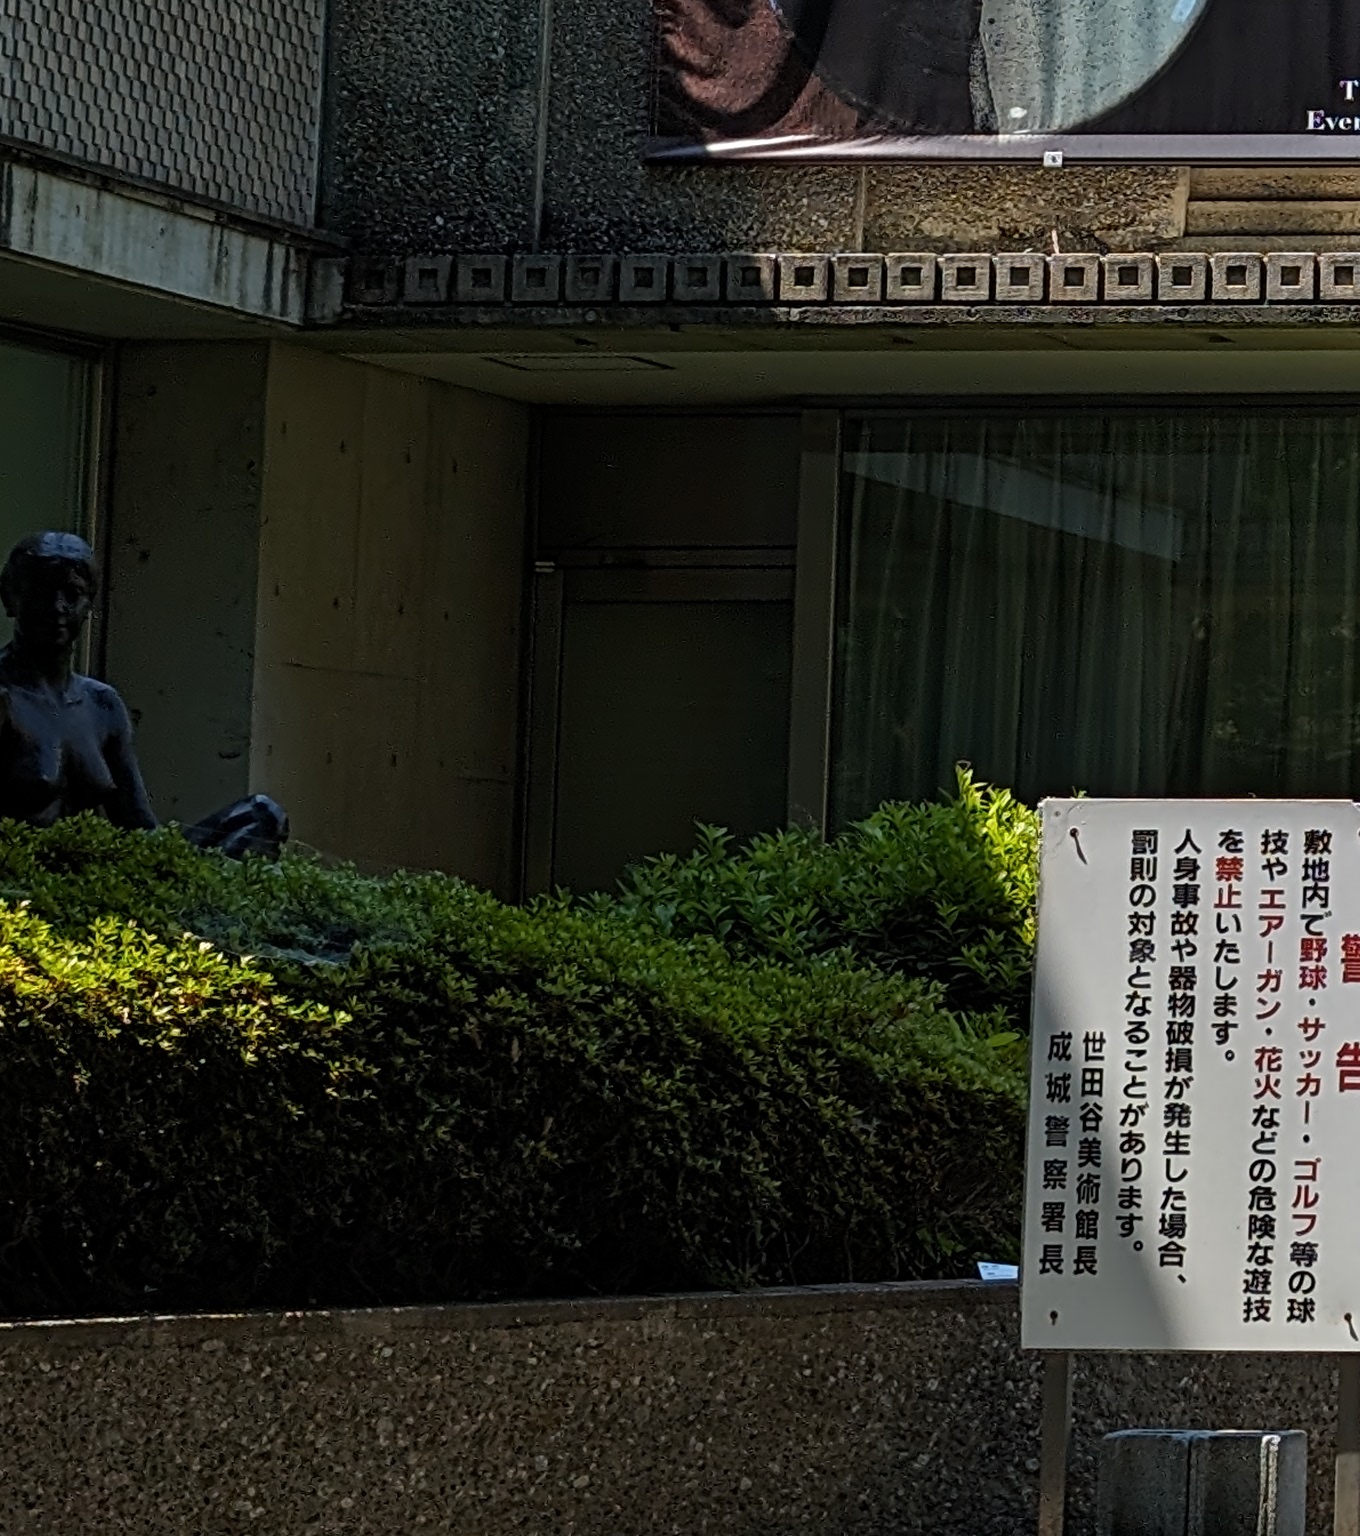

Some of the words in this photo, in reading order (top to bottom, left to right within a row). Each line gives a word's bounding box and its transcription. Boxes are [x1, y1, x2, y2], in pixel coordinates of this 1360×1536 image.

[1115, 829, 1159, 1252] 罰則の対象となることがあります。
[1157, 829, 1202, 1285] 人身事故や器物破損が発生した場合、
[1211, 829, 1245, 1063] を禁止いたします。
[1038, 1031, 1073, 1276] 成城警察署長
[1073, 1031, 1106, 1276] 世田谷美術館長
